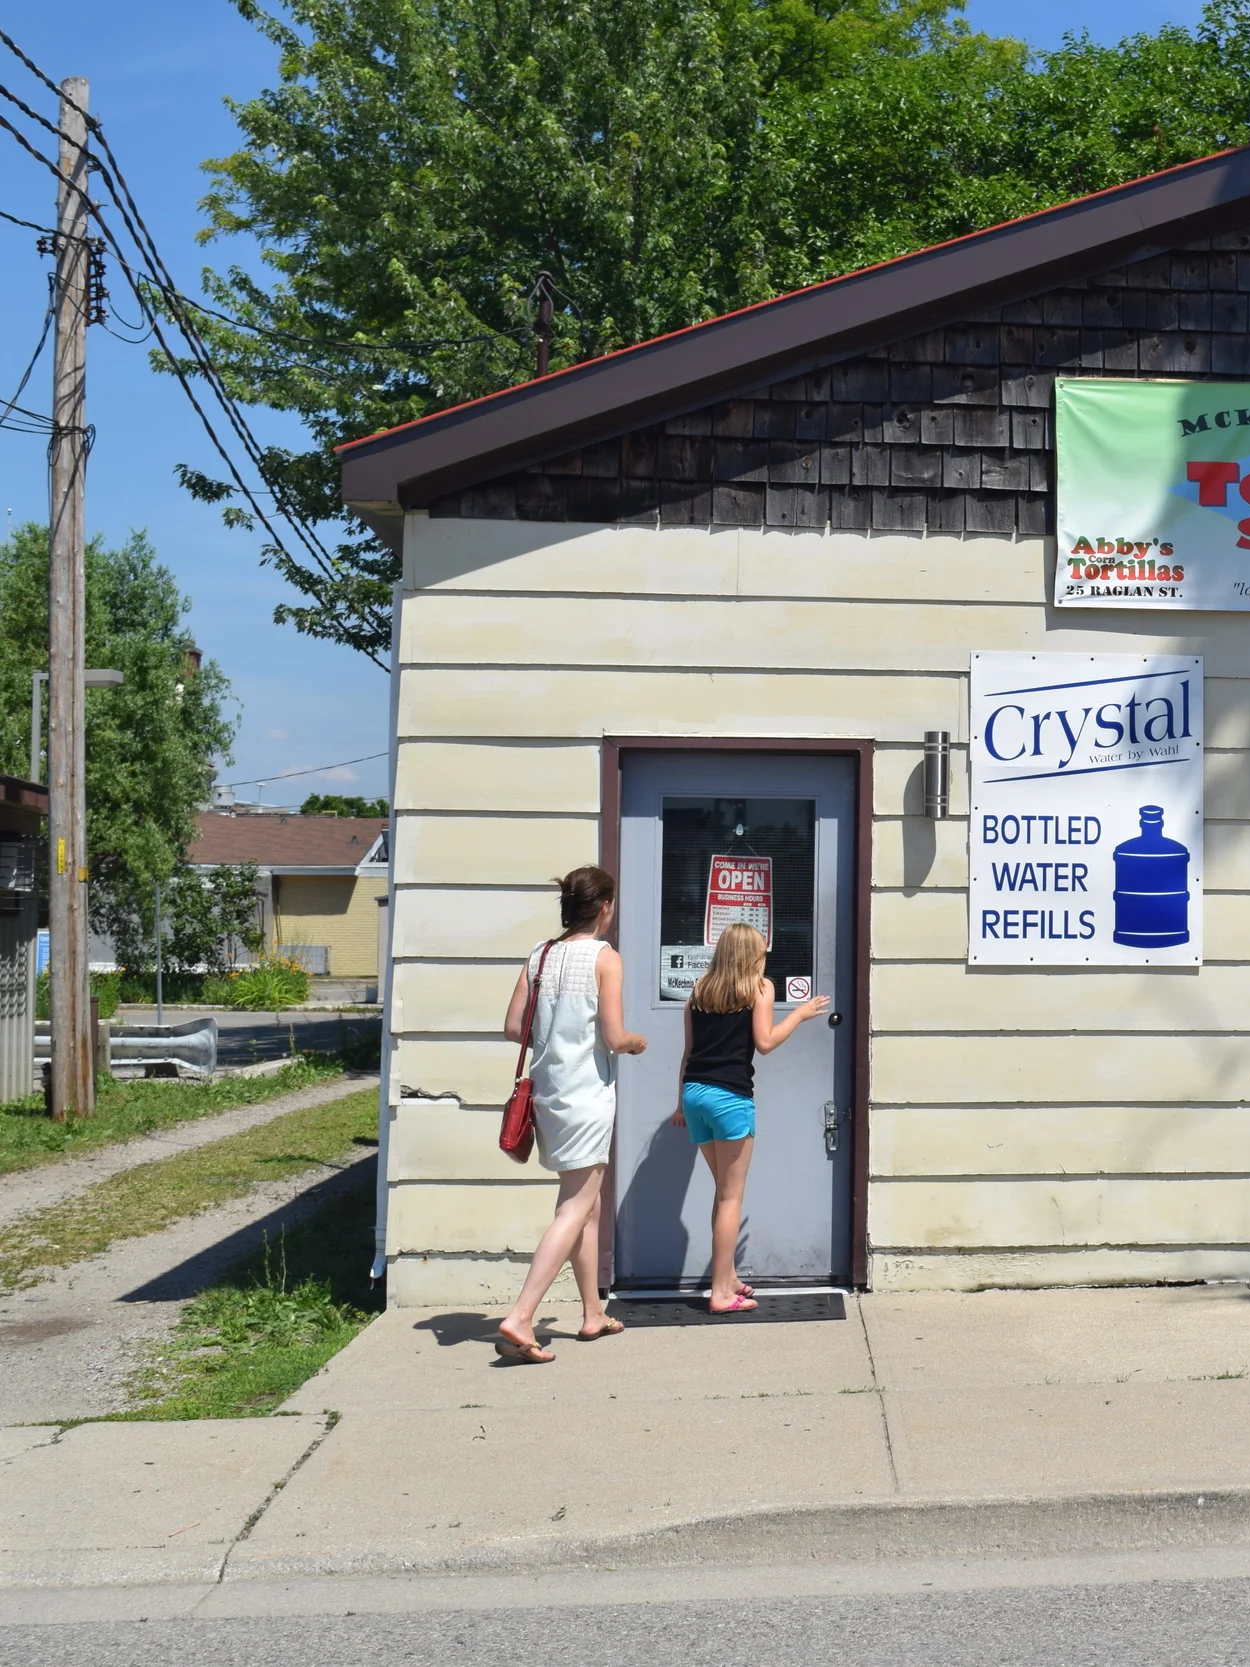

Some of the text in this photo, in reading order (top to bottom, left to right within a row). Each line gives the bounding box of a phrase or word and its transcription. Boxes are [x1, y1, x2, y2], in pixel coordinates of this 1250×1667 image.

[1070, 535, 1174, 560] Abby's
[1088, 555, 1116, 564] Corn
[1067, 557, 1185, 582] Tortillas
[1065, 585, 1184, 598] 25 RAGLAN ST.
[984, 678, 1193, 769] Crystal
[1089, 744, 1180, 765] Water by Wahl
[982, 814, 1102, 845] BOTTLED
[714, 861, 769, 871] COME IN WE'RE
[991, 862, 1089, 892] WATER
[718, 870, 765, 891] OPEN
[981, 909, 1096, 940] REFILLS
